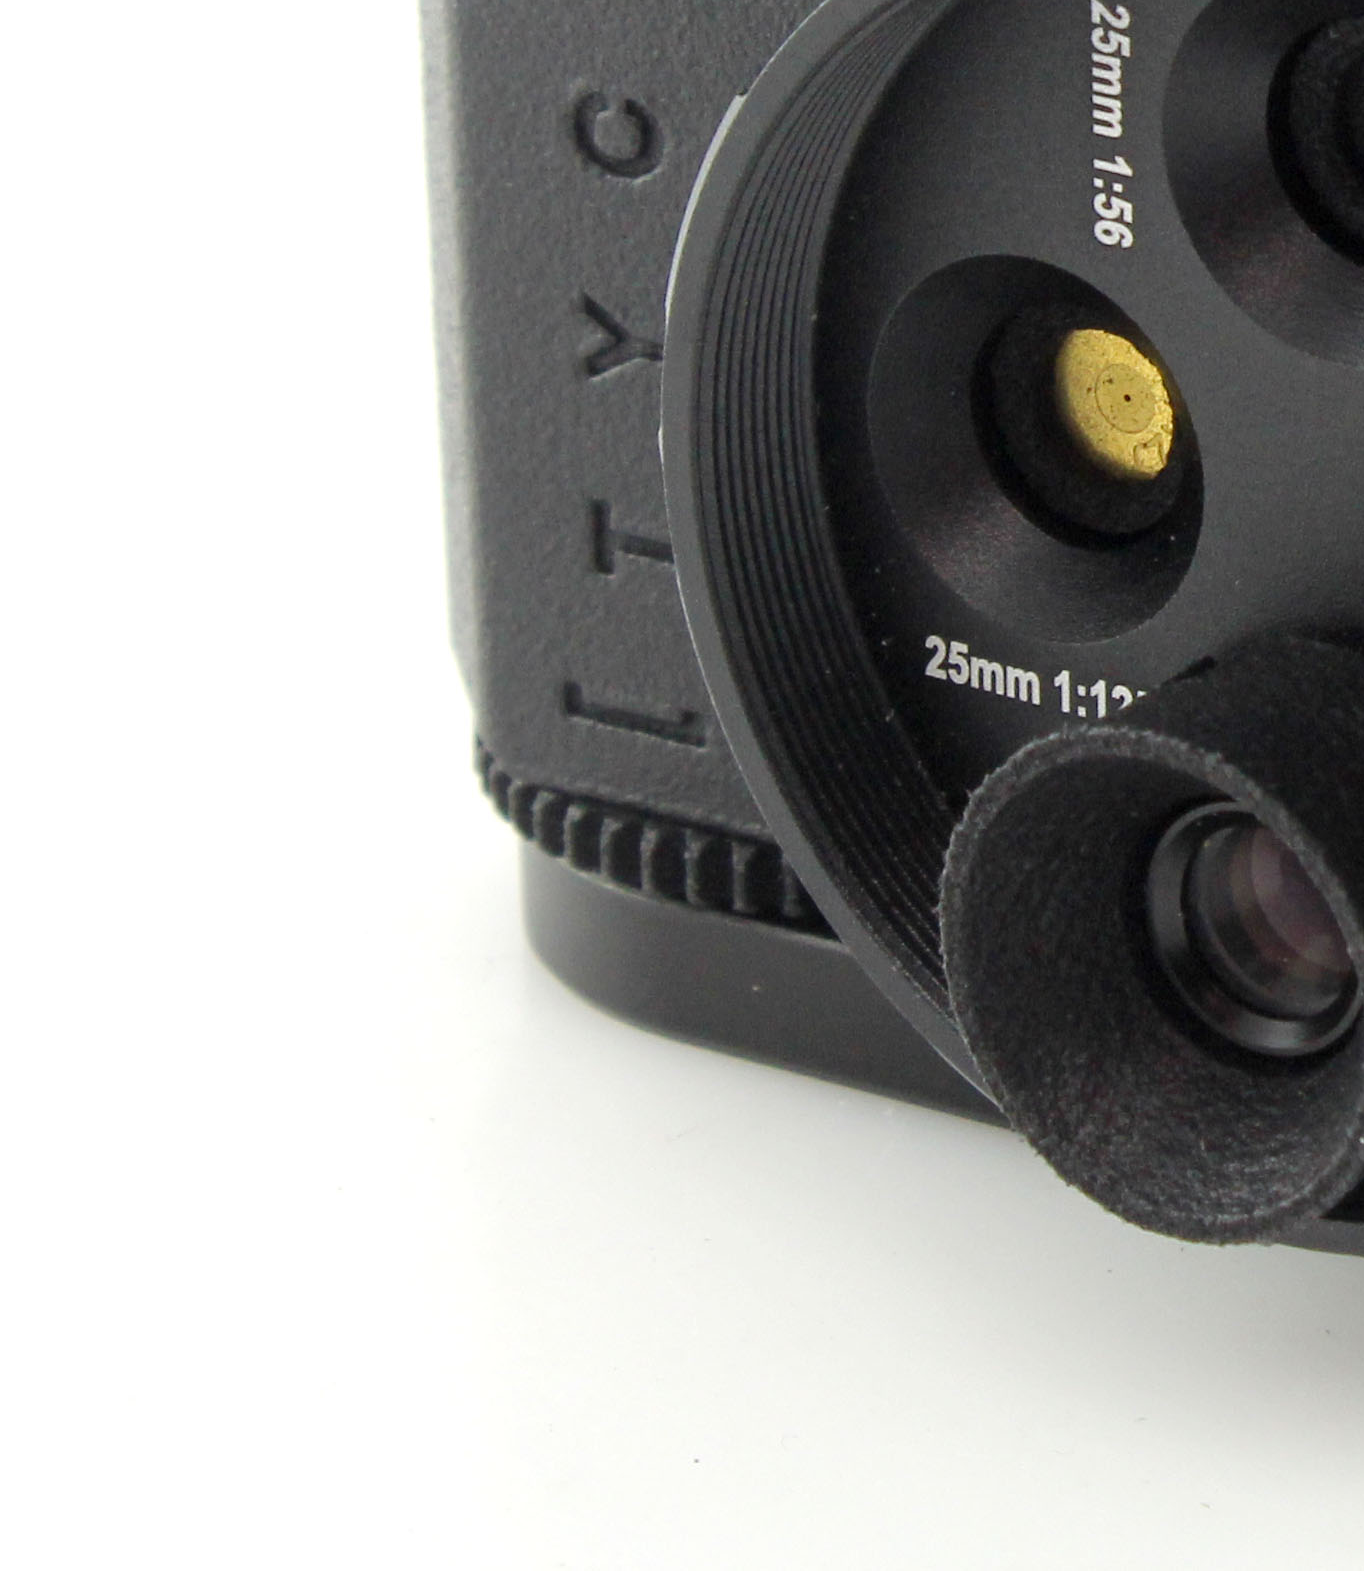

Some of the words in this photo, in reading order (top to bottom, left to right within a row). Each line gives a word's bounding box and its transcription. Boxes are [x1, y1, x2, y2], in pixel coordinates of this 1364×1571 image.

[1093, 155, 1134, 249] 1:56
[924, 634, 1041, 706] 25mm
[1053, 669, 1148, 719] 1:12
